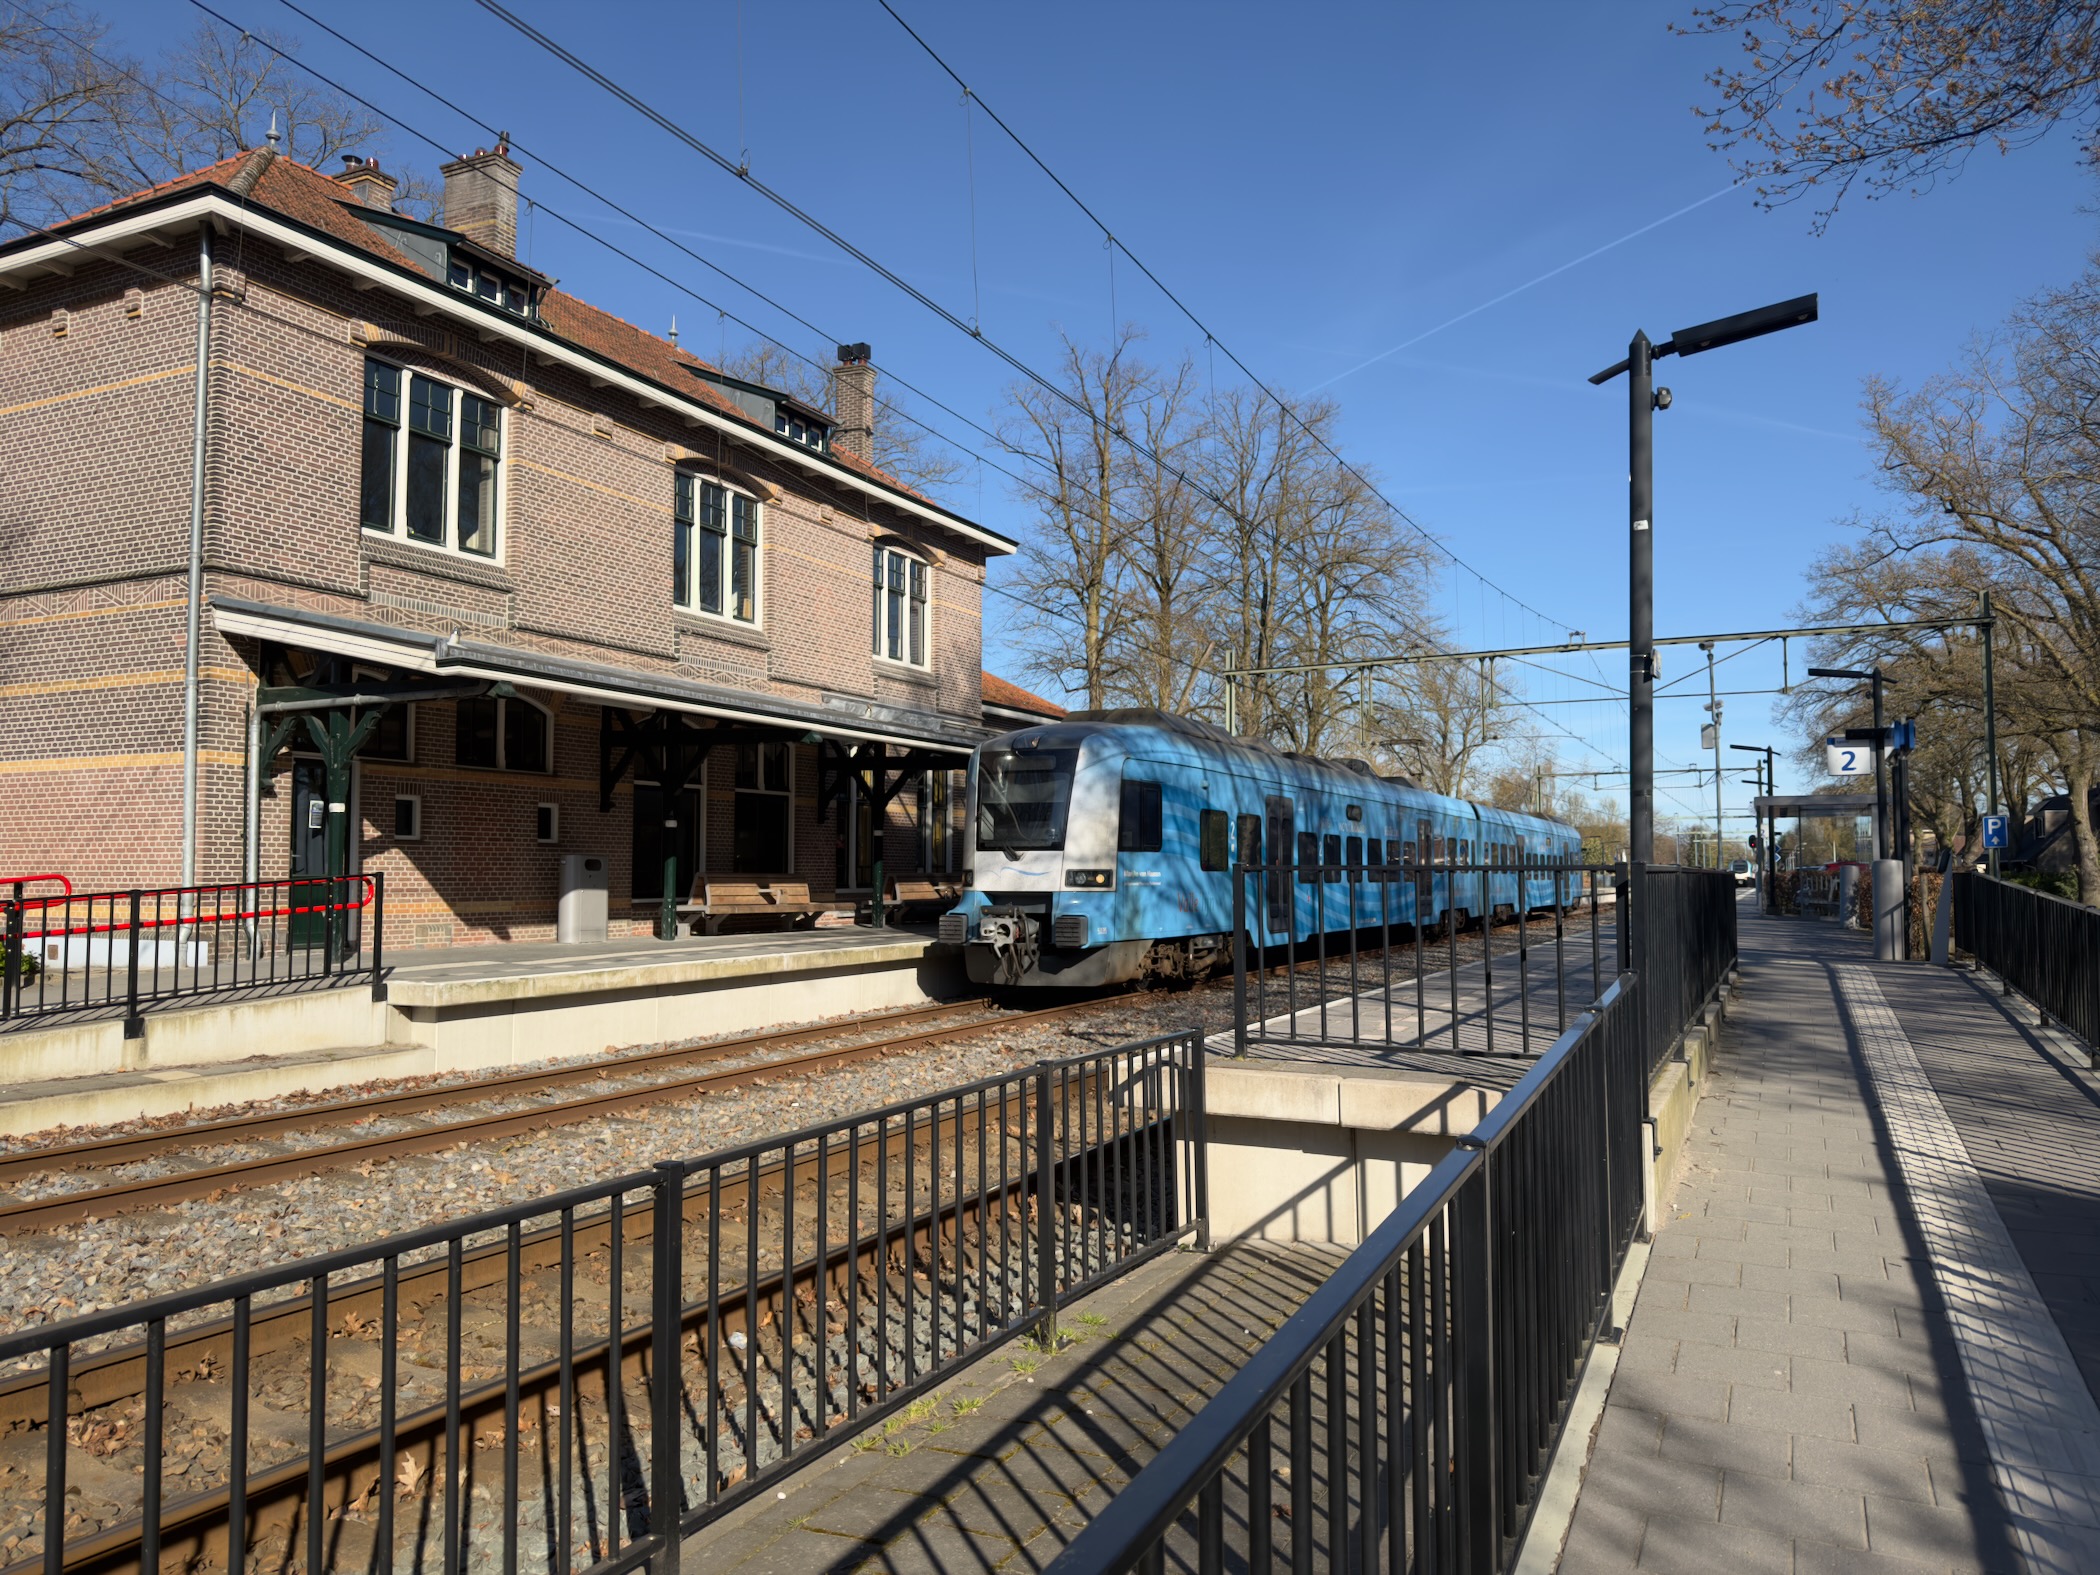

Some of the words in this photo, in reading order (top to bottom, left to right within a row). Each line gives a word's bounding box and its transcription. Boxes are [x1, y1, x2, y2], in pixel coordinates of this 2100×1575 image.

[1841, 750, 1857, 771] 2
[1230, 821, 1235, 840] 2
[1988, 818, 2002, 835] P
